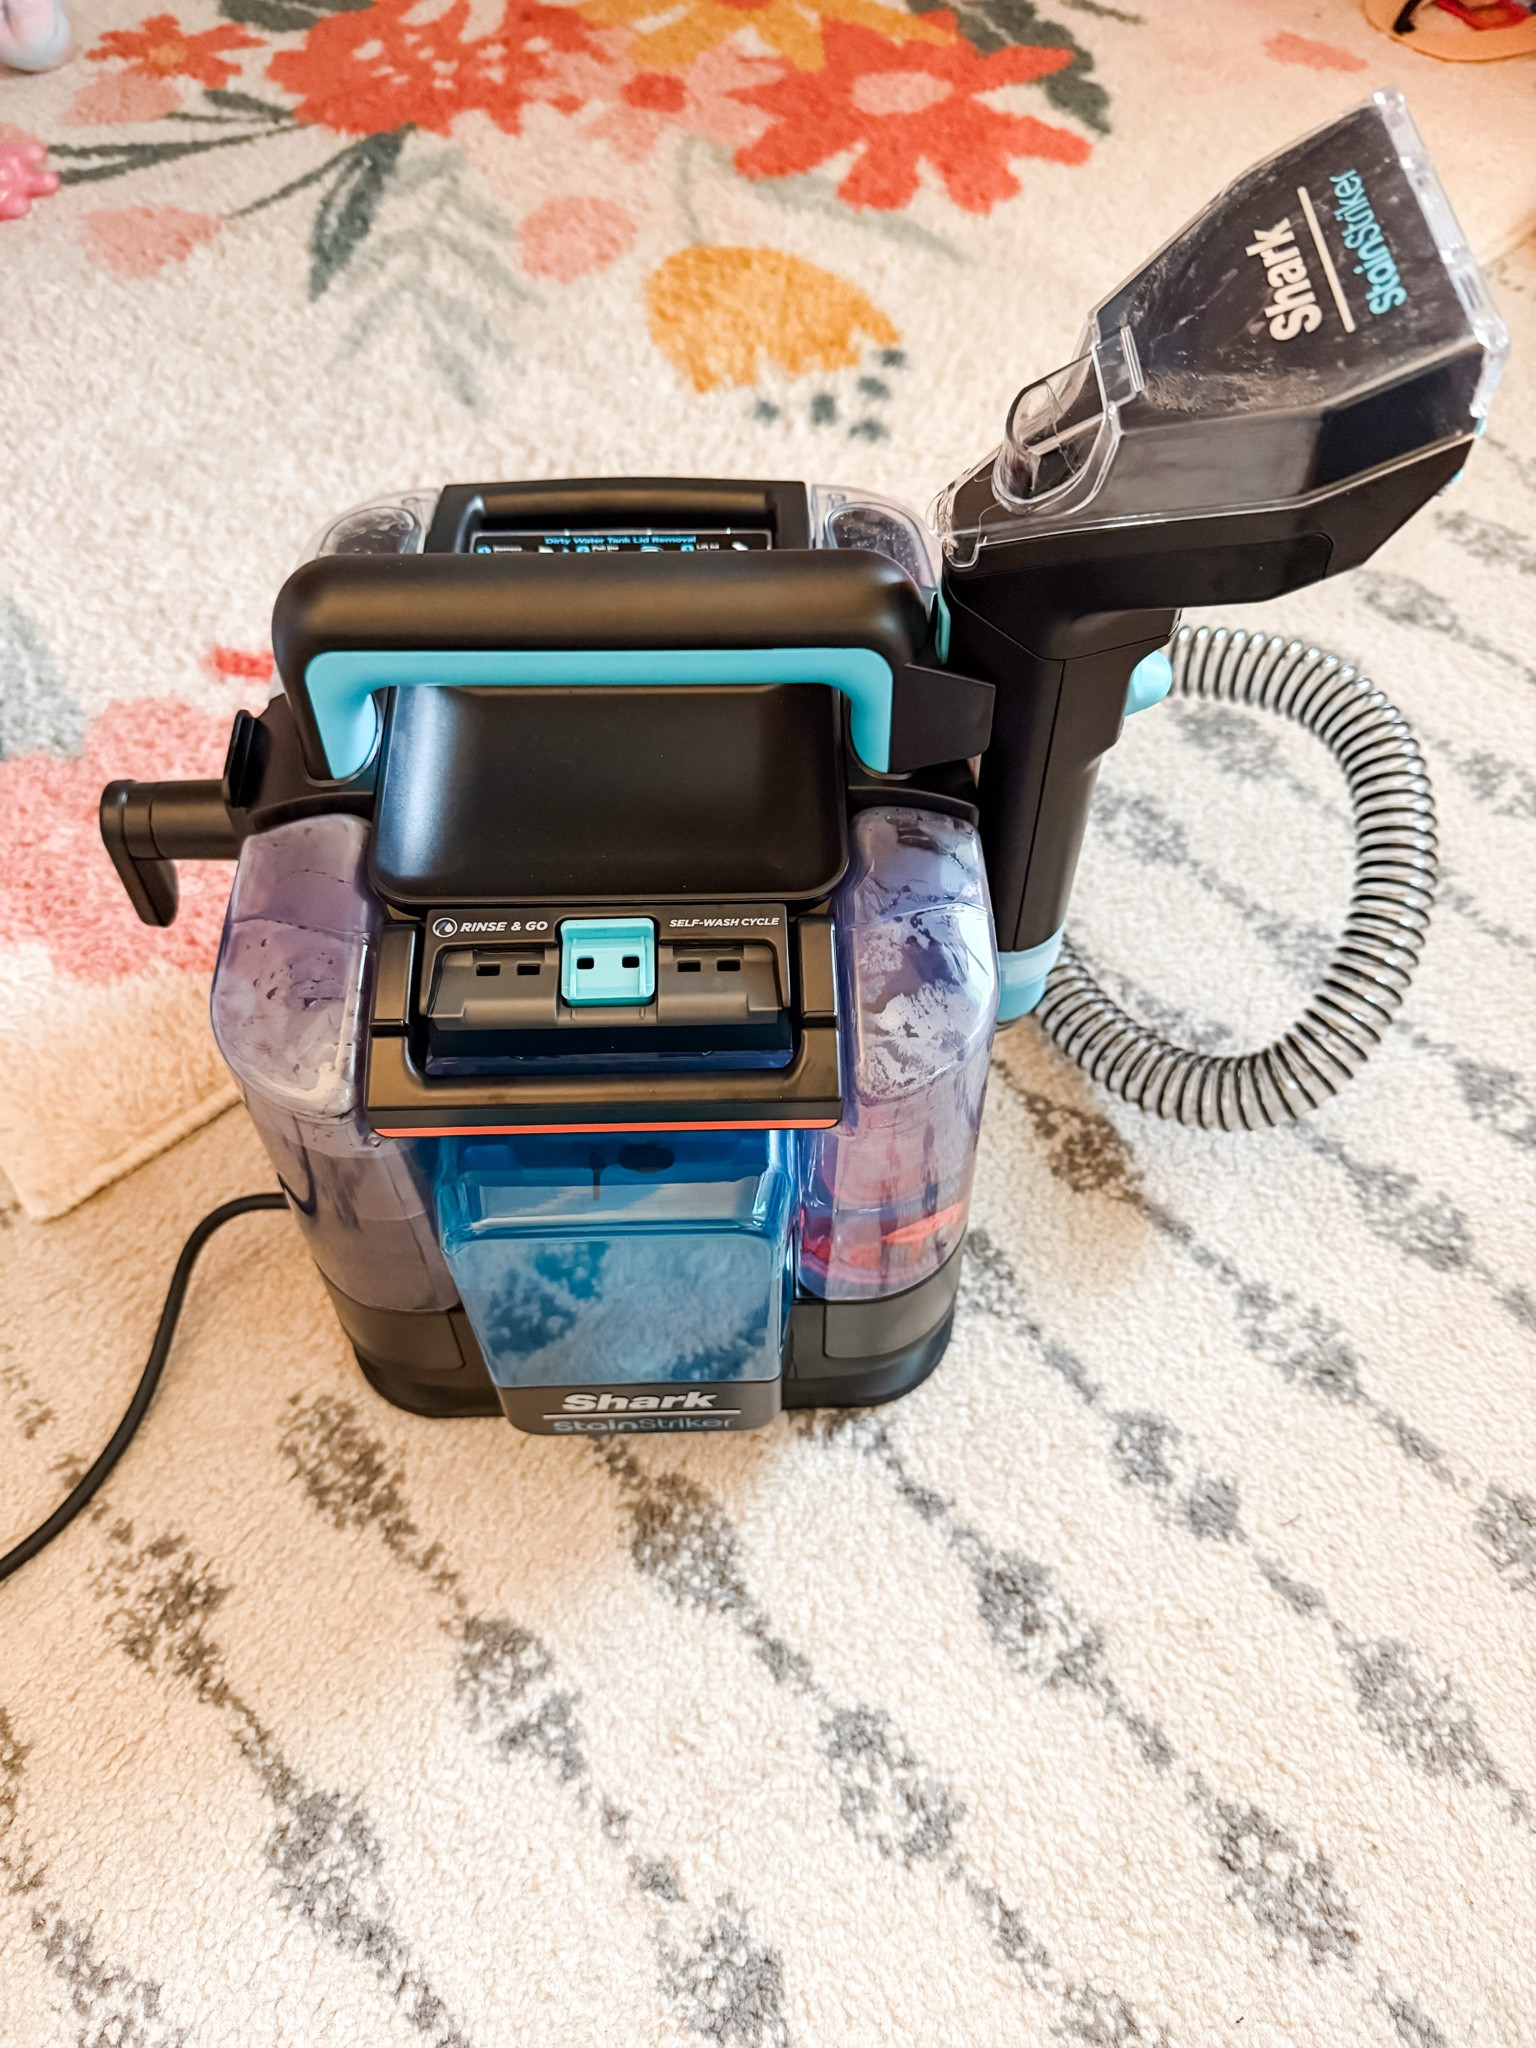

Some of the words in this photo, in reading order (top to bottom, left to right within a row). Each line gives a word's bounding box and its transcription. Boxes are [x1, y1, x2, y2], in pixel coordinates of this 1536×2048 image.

[1329, 169, 1407, 315] StainStriker
[1245, 217, 1322, 341] Shark
[545, 537, 571, 545] Dirty
[460, 921, 507, 932] RINSE
[510, 921, 521, 931] &
[525, 921, 548, 931] GO
[669, 919, 739, 927] SELF-WASH
[741, 917, 780, 926] CYCLE
[562, 1391, 717, 1411] Shark
[553, 1418, 733, 1432] StainStriker
